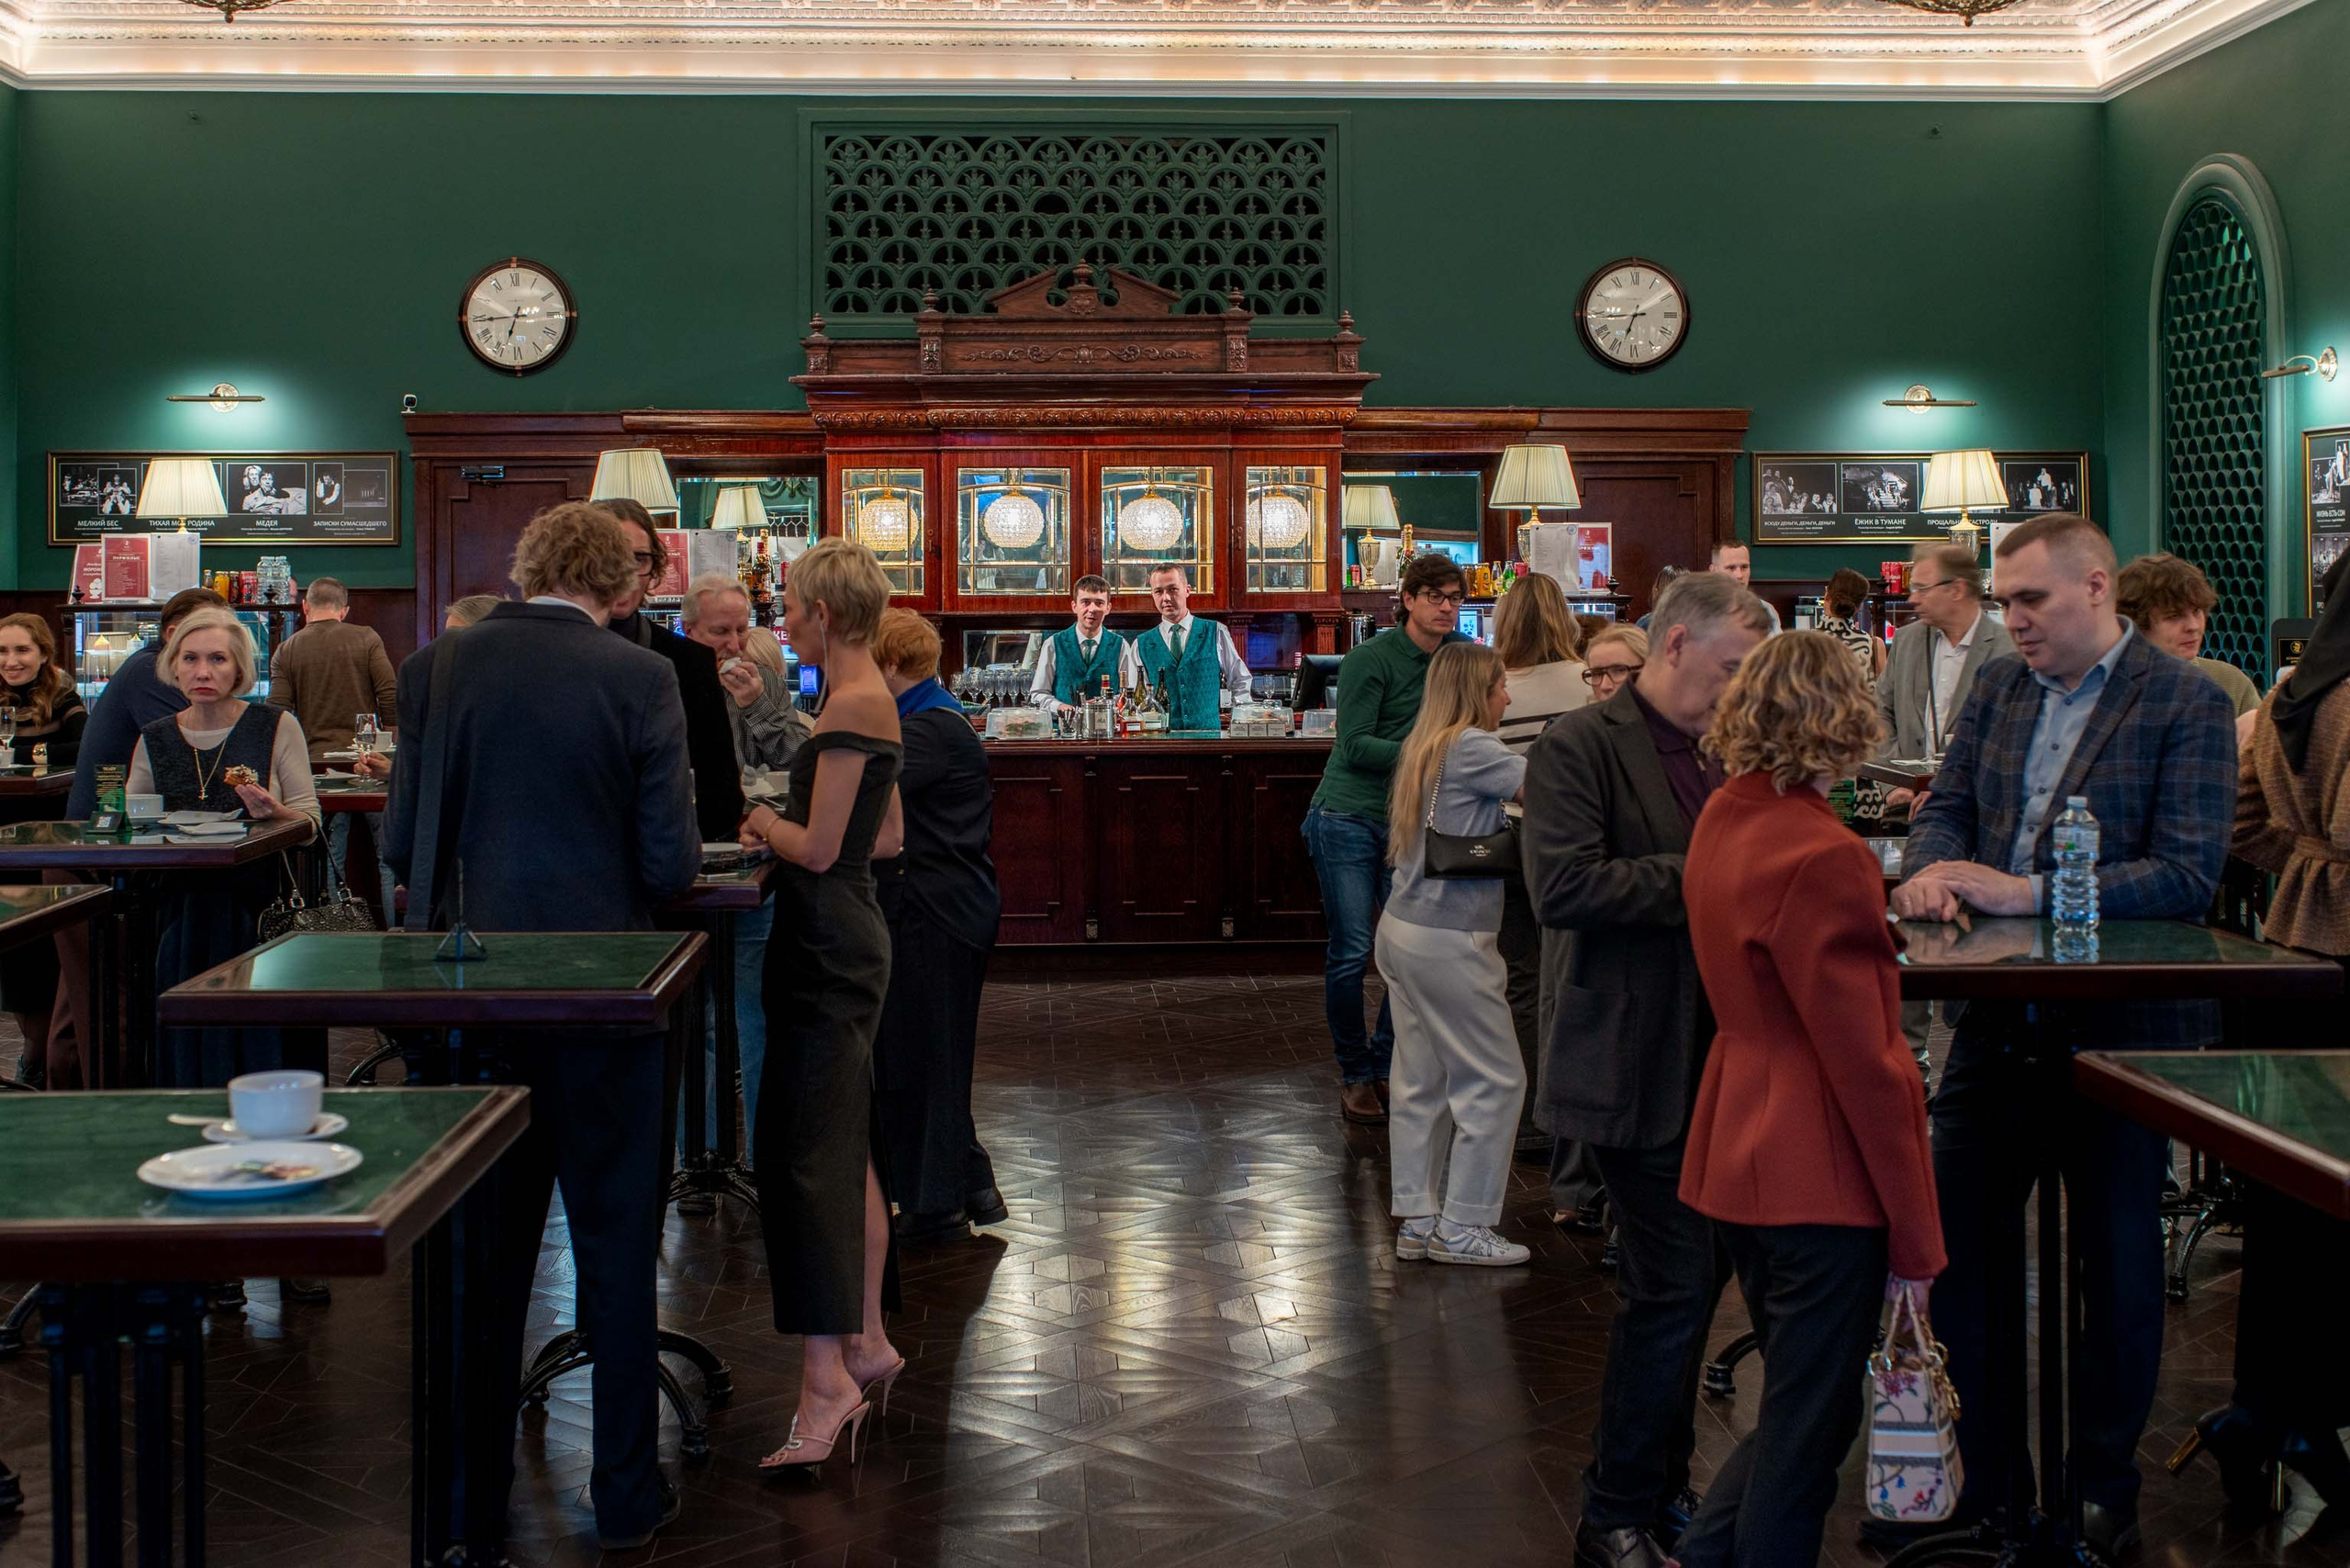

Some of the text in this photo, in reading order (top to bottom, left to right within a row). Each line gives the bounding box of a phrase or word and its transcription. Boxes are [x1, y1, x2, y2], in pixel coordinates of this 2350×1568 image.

[509, 272, 520, 286] XII
[1630, 271, 1639, 286] XII
[77, 519, 105, 527] МЕЛКИЙ
